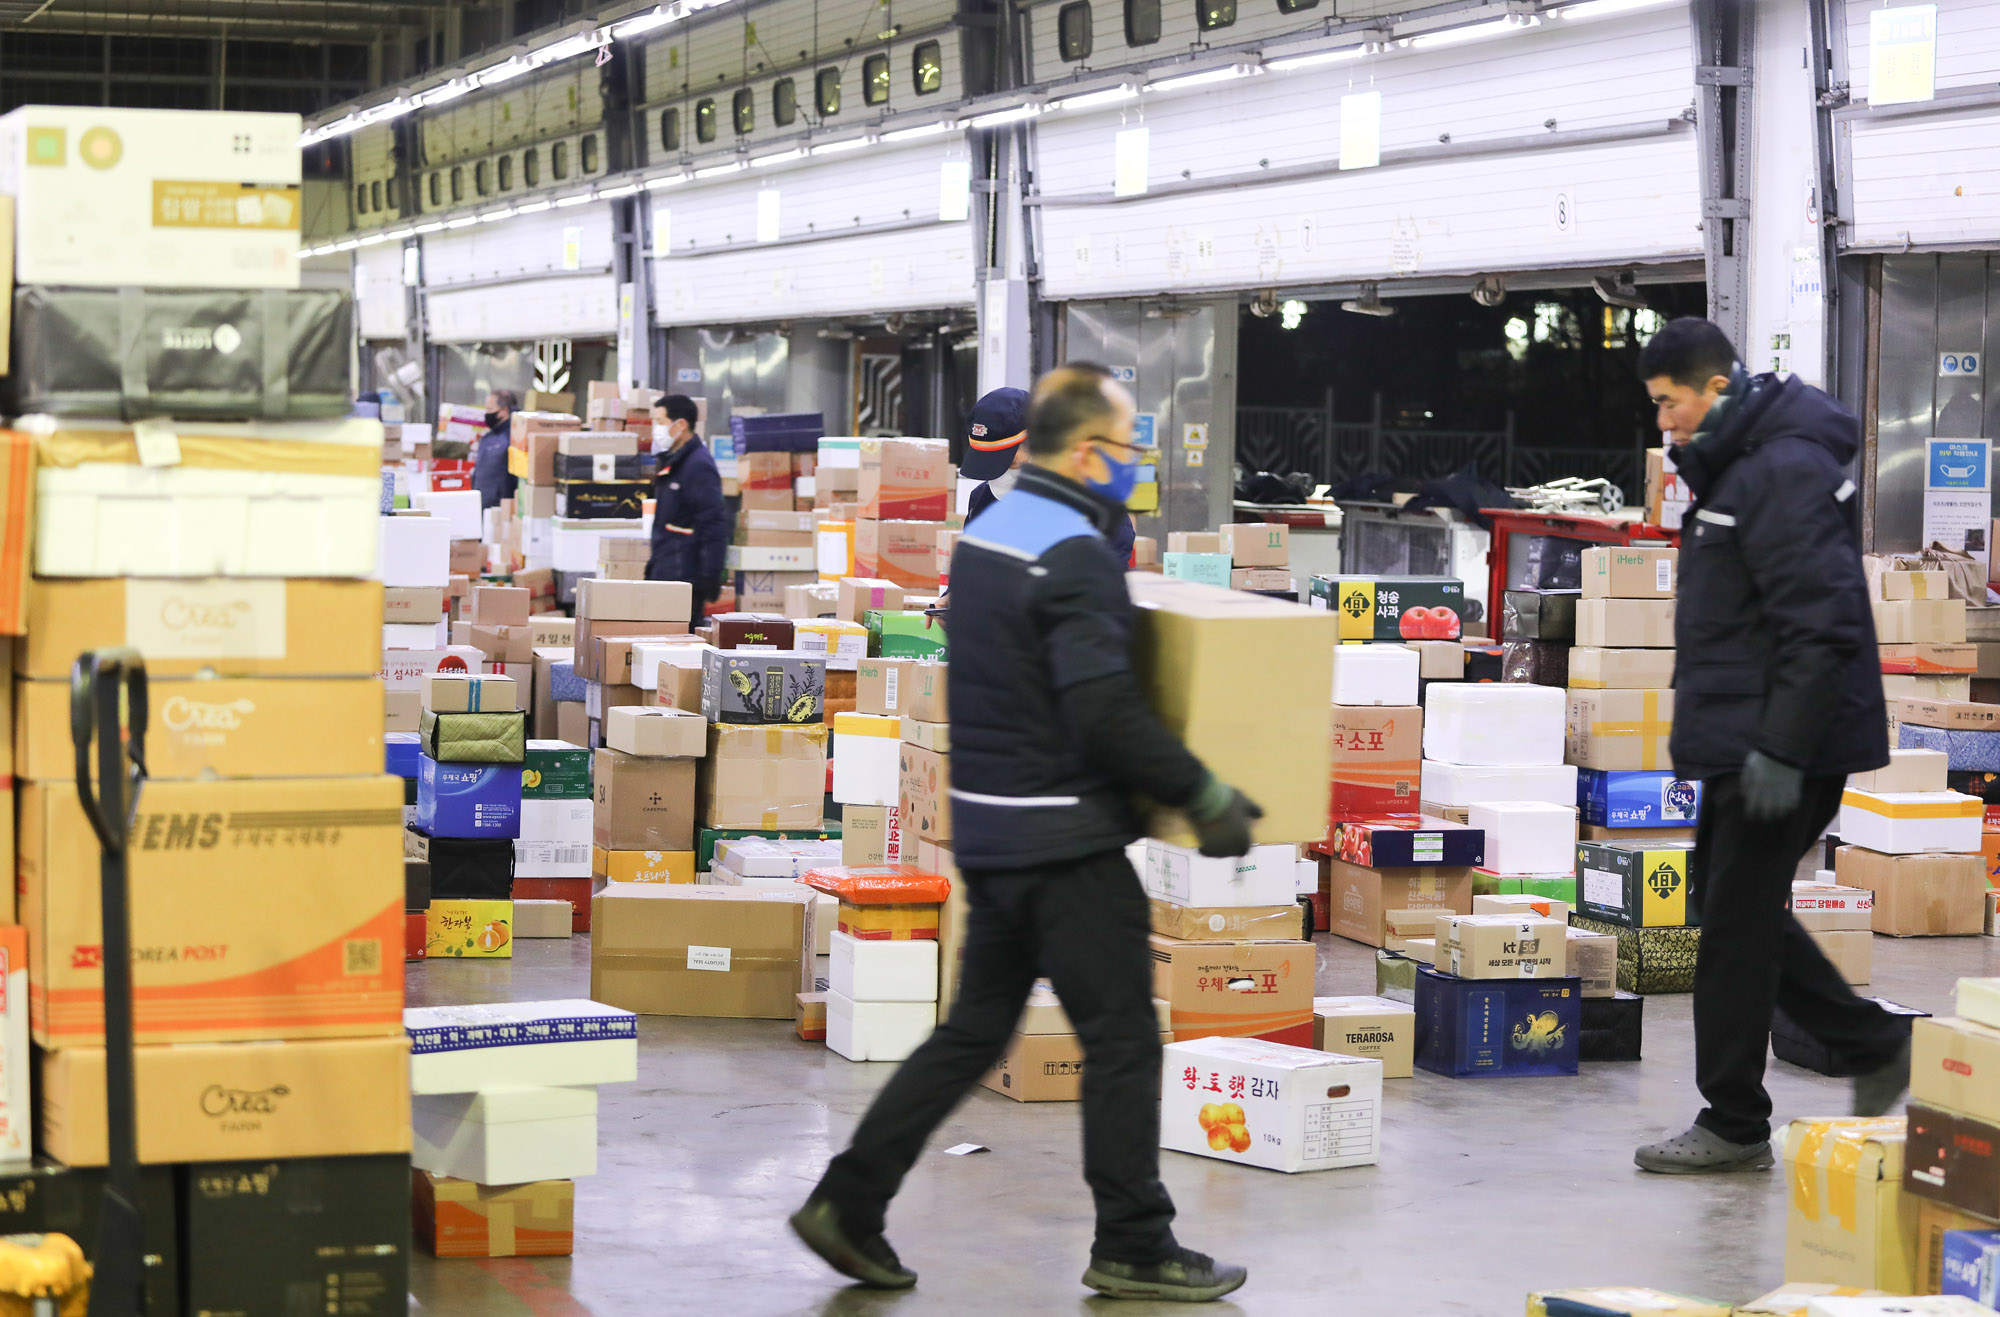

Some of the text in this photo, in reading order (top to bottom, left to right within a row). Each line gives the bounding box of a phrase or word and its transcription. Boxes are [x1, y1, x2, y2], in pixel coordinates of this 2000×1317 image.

[1558, 202, 1567, 224] 8
[1617, 555, 1644, 566] iHerb
[1377, 590, 1400, 604] 청송
[1376, 605, 1400, 619] 사과
[860, 666, 878, 678] iHerb
[460, 772, 478, 783] 쇼핑
[1630, 809, 1647, 820] 쇼핑
[144, 812, 223, 852] EMS
[440, 915, 473, 930] 한라봉
[183, 944, 228, 962] POST
[1503, 942, 1536, 953] kt 5G
[1346, 1032, 1394, 1043] TERAROSA
[201, 1084, 290, 1116] Crea
[1263, 1134, 1281, 1146] 10kg
